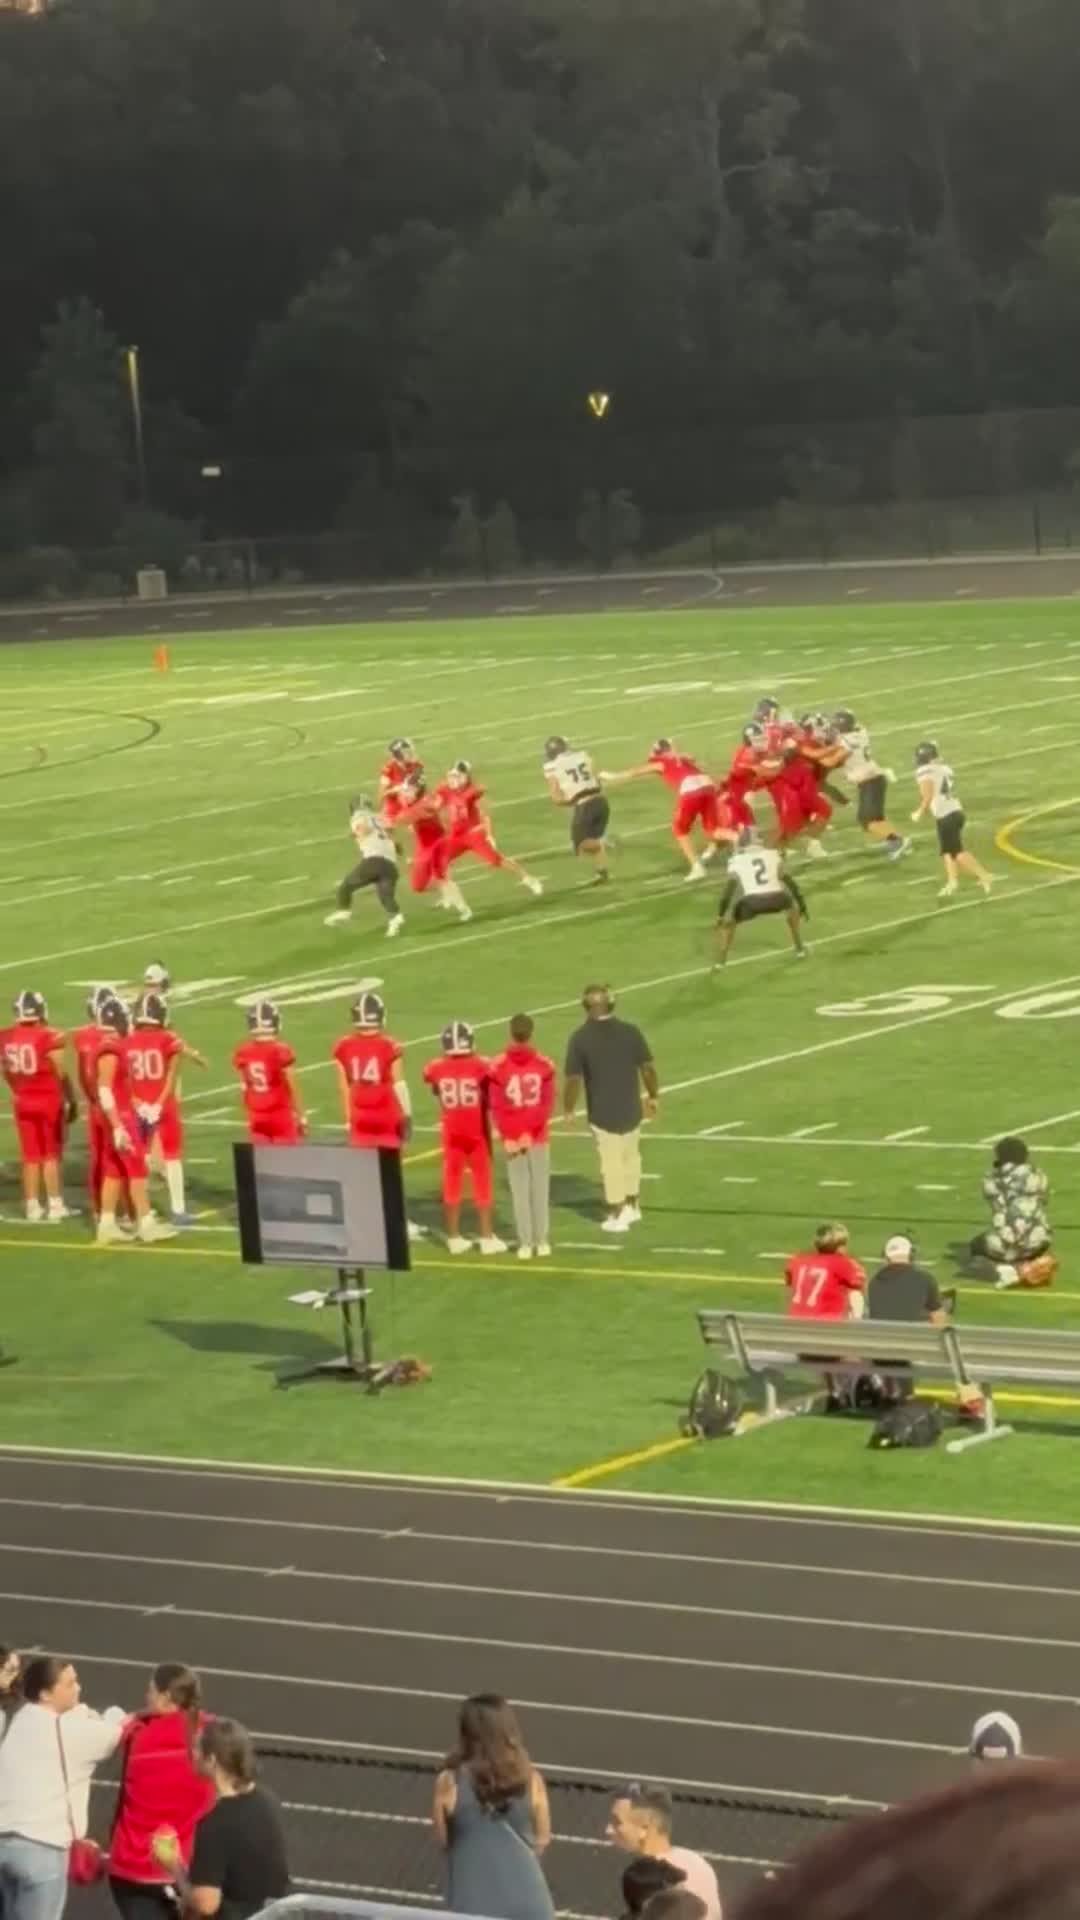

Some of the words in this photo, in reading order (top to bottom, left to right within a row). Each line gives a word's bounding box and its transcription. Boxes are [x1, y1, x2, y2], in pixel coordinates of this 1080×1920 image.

[751, 858, 768, 884] 2
[128, 1049, 164, 1080] 30
[249, 1061, 269, 1092] 5
[351, 1055, 381, 1083] 14
[439, 1078, 479, 1108] 86
[505, 1073, 541, 1107] 43
[792, 1266, 827, 1305] 17
